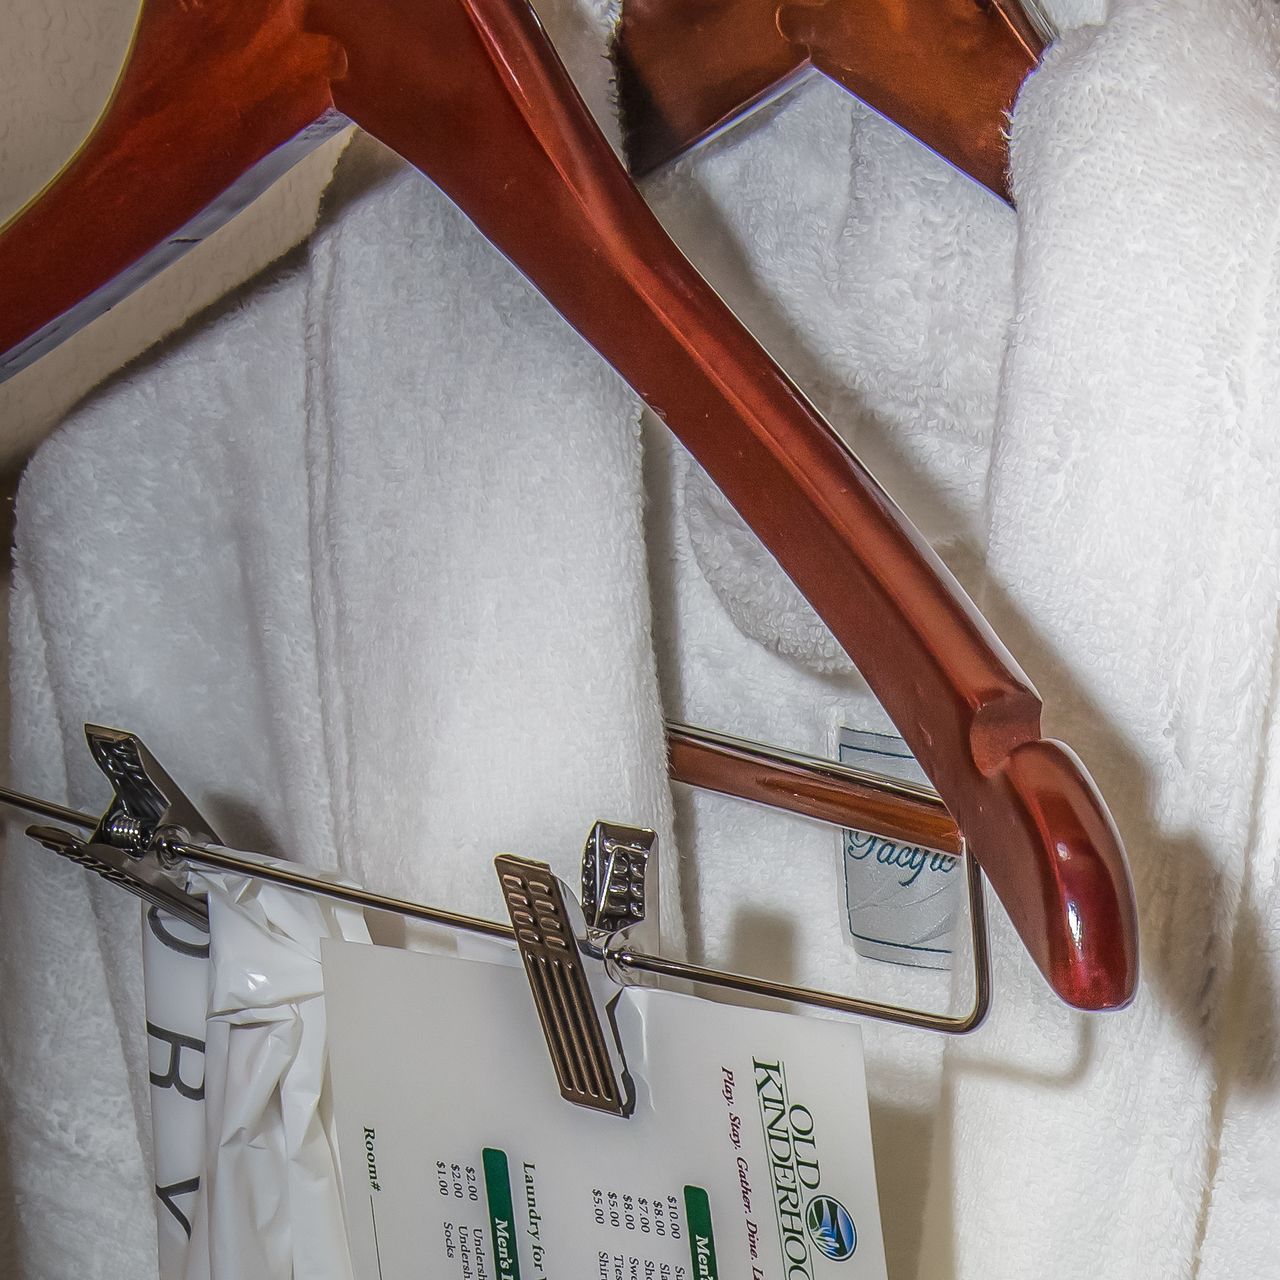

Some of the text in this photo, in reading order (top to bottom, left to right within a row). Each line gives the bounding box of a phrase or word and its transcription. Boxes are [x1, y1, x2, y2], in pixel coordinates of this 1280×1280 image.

[719, 1066, 737, 1107] Play.
[726, 1112, 744, 1151] Stay.
[787, 1102, 822, 1191] OLD
[362, 1126, 382, 1191] Room#
[449, 1162, 463, 1199] $2.00
[464, 1165, 478, 1202] $2.00
[735, 1156, 755, 1215] Gather.
[434, 1160, 448, 1196] $1.00
[443, 1221, 456, 1259] Socks
[519, 1161, 541, 1241] Laundry
[531, 1244, 546, 1272] for
[590, 1188, 605, 1225] $5.00
[605, 1191, 620, 1228] $5.00
[620, 1194, 635, 1231] $8.00
[636, 1196, 650, 1234] $7.00
[651, 1199, 666, 1237] $8.00
[666, 1195, 681, 1239] $10.00
[494, 1217, 512, 1270] Men's
[745, 1219, 761, 1261] Dine.
